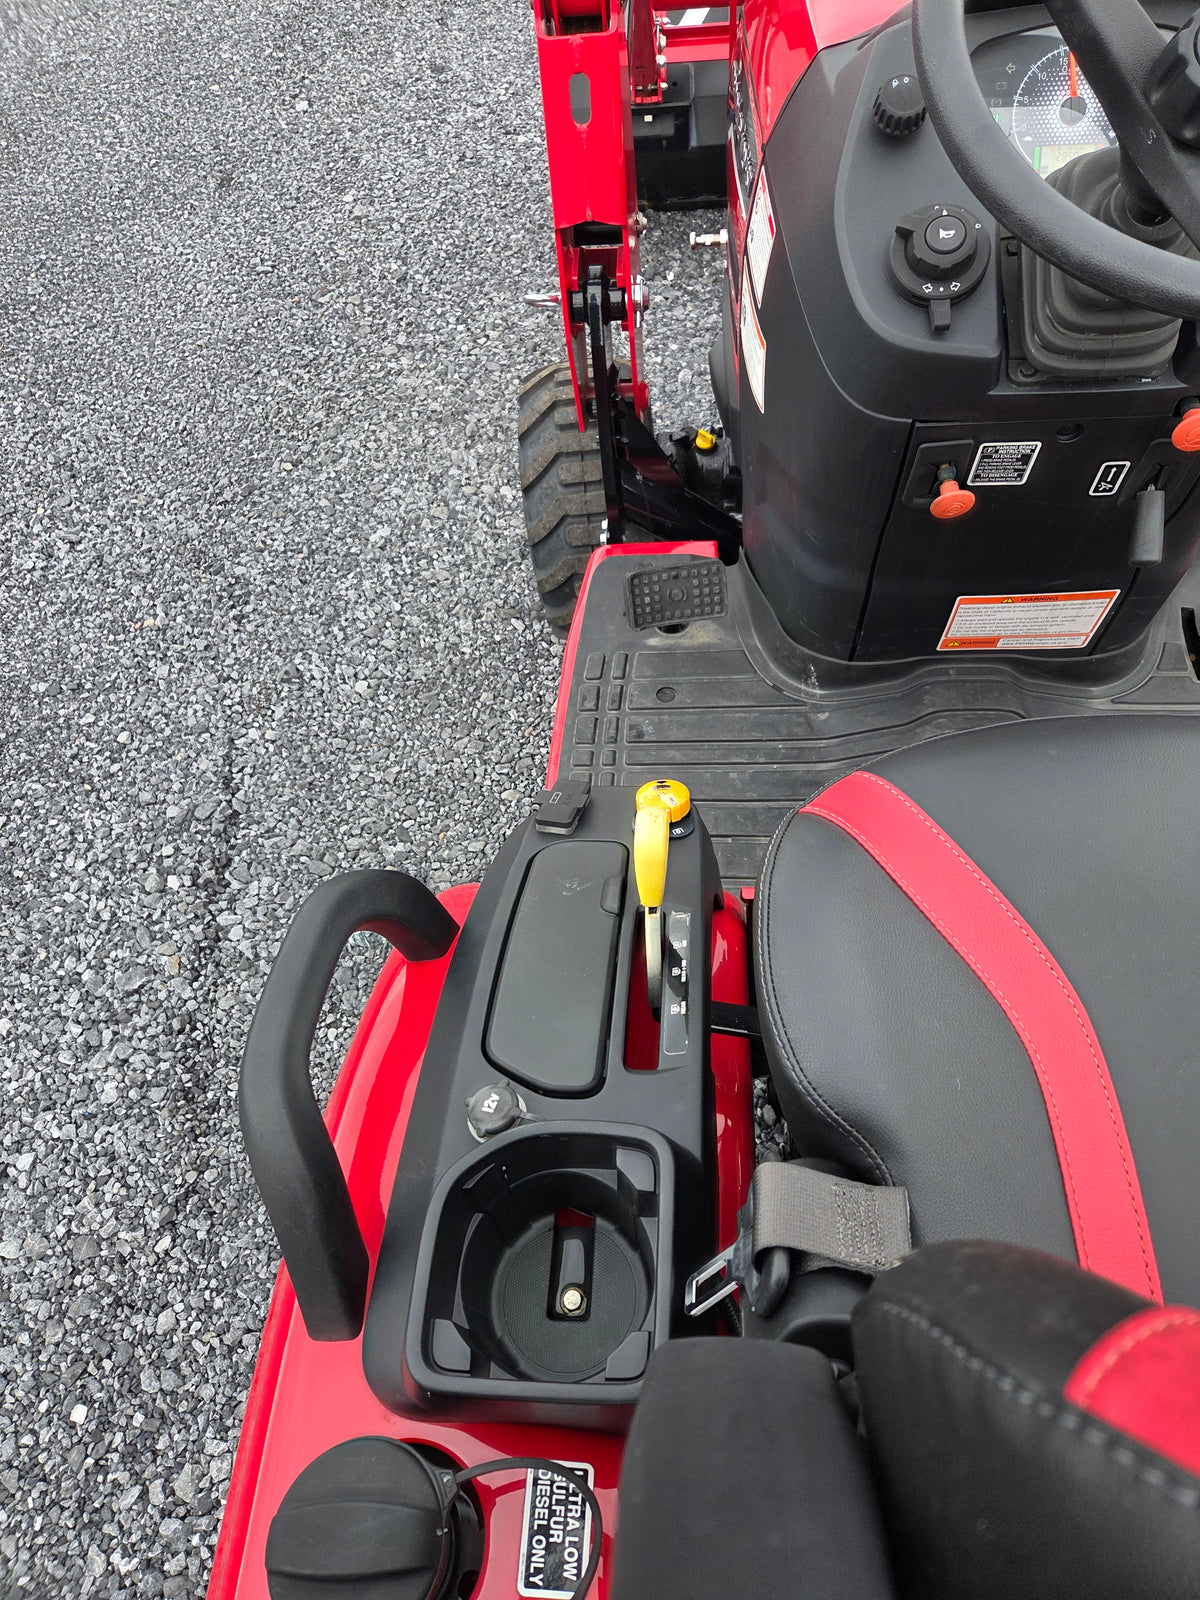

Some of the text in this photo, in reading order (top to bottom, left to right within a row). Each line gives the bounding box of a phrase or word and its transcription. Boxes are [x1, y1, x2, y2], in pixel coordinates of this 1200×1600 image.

[1060, 58, 1068, 66] 15
[1037, 72, 1046, 80] 10
[1024, 95, 1029, 104] 5
[481, 1093, 500, 1113] 12V
[529, 1468, 551, 1587] DIESEL ONLY
[562, 1470, 583, 1581] LTRA LOW
